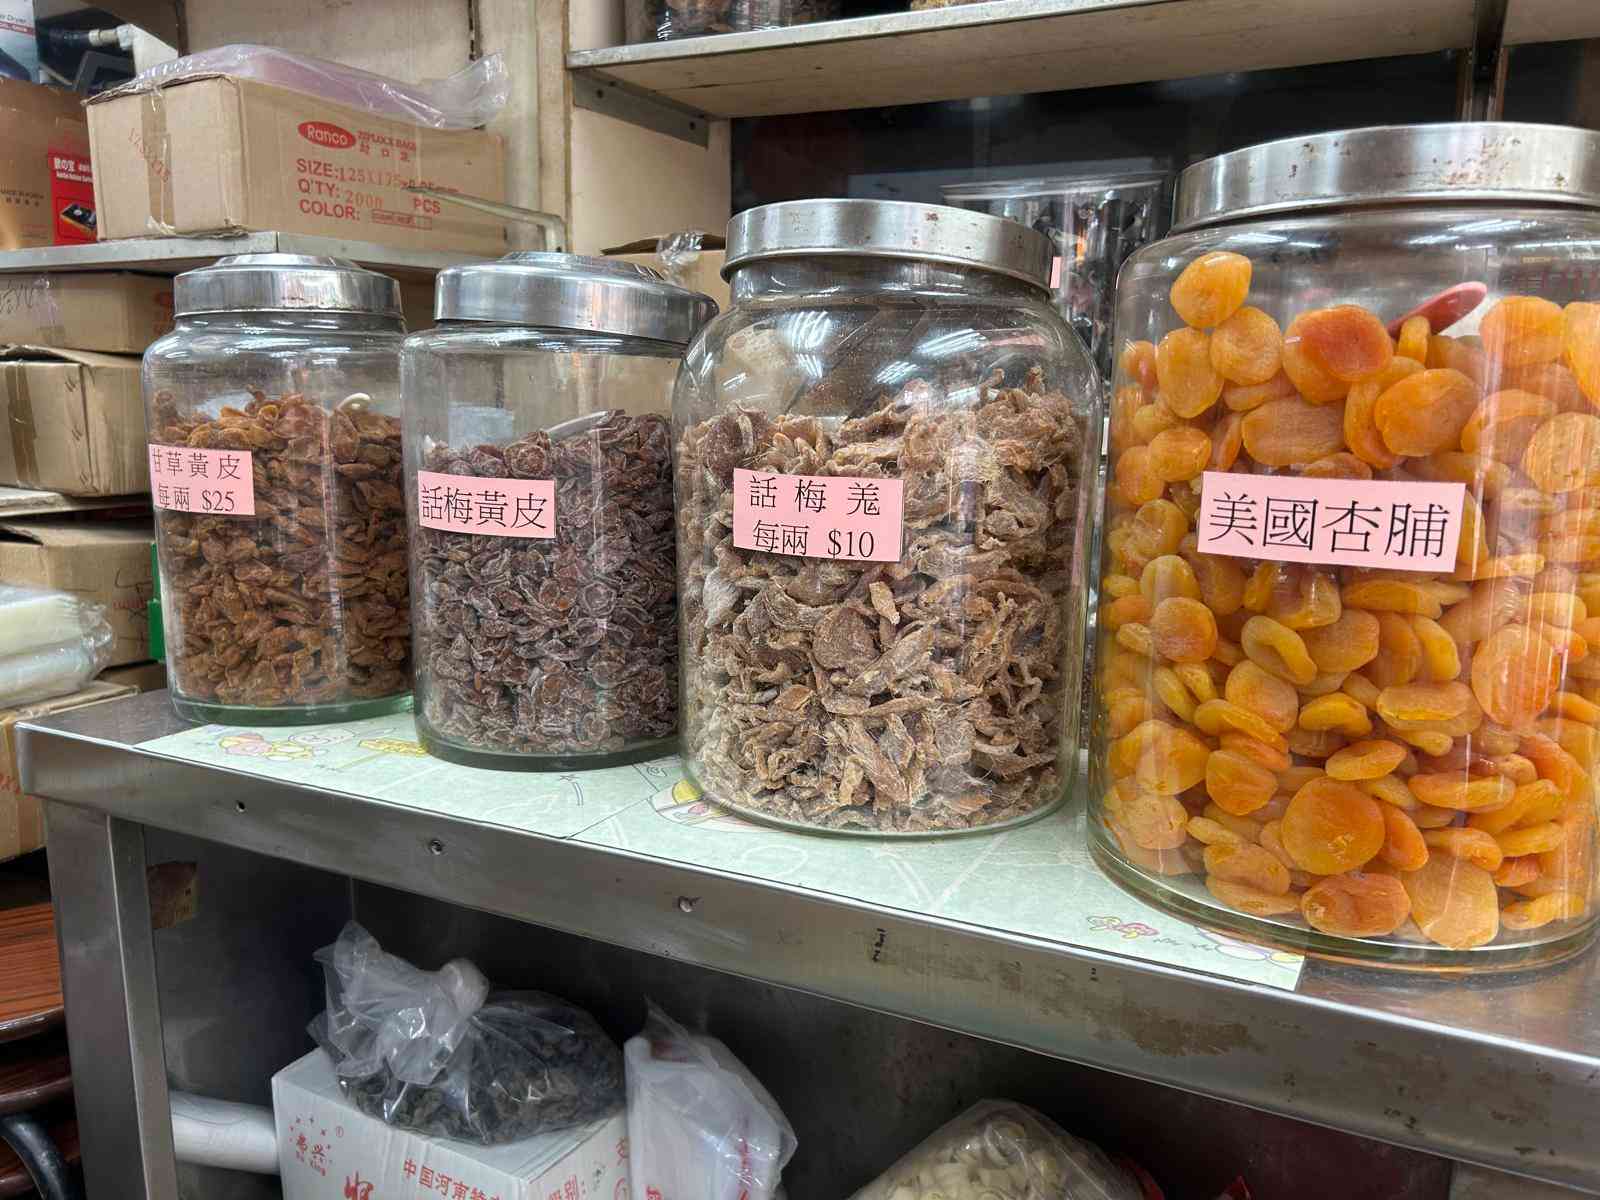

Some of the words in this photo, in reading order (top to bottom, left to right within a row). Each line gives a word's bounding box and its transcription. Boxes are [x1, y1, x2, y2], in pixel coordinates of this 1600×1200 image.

[306, 124, 348, 146] Ranco
[297, 178, 341, 198] Q'TY:
[413, 198, 441, 214] PCS
[299, 199, 361, 221] COLOR:
[201, 488, 235, 513] $25
[752, 519, 810, 556] 每兩
[827, 528, 875, 558] $10
[1207, 490, 1450, 558] 美國杏脯
